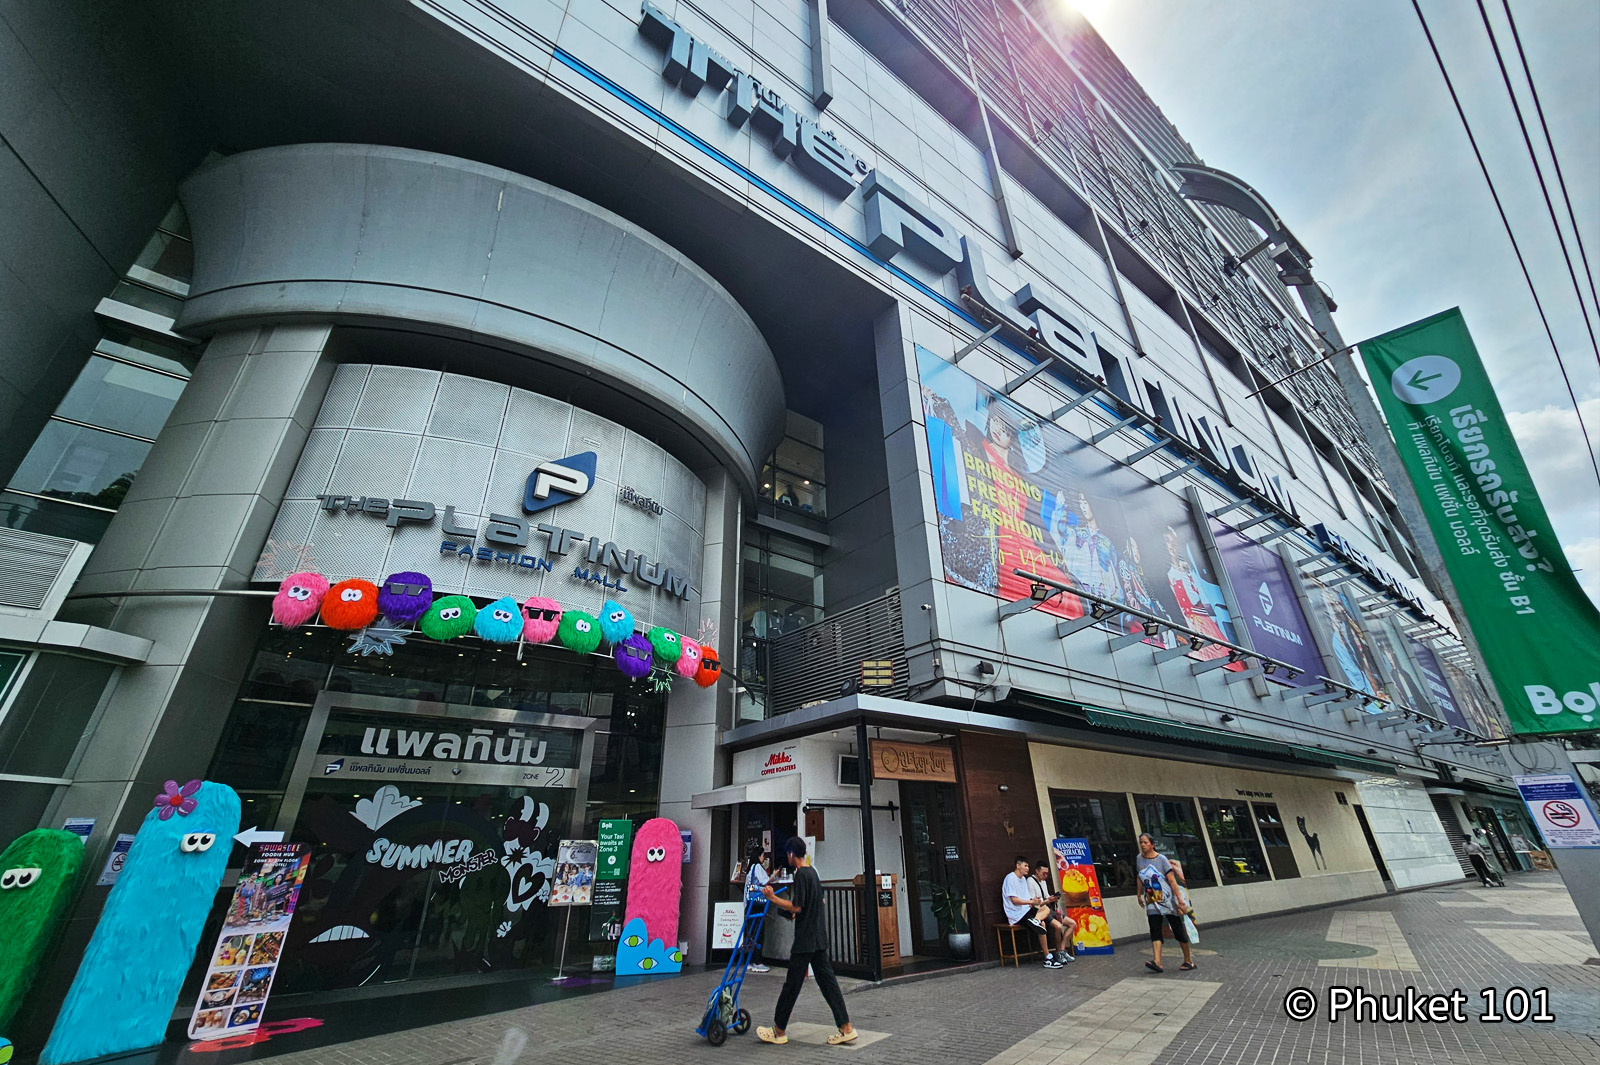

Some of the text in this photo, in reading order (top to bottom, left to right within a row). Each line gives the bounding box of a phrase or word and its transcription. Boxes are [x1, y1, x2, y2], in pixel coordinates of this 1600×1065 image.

[963, 451, 1042, 502] BRINGING
[967, 475, 1020, 514] FRESH
[1449, 404, 1554, 573] เรียกรถรับส่ง?
[971, 498, 1044, 544] FASHION
[440, 541, 628, 593] FASHION MALL
[1510, 595, 1536, 615] B1
[360, 727, 548, 765] แพลทินัม
[544, 767, 566, 788] 2
[761, 764, 796, 776] COFFEE ROASTERS
[258, 844, 301, 852] SAWASDEE
[365, 837, 474, 871] SUMMER
[438, 848, 499, 884] MONSTER
